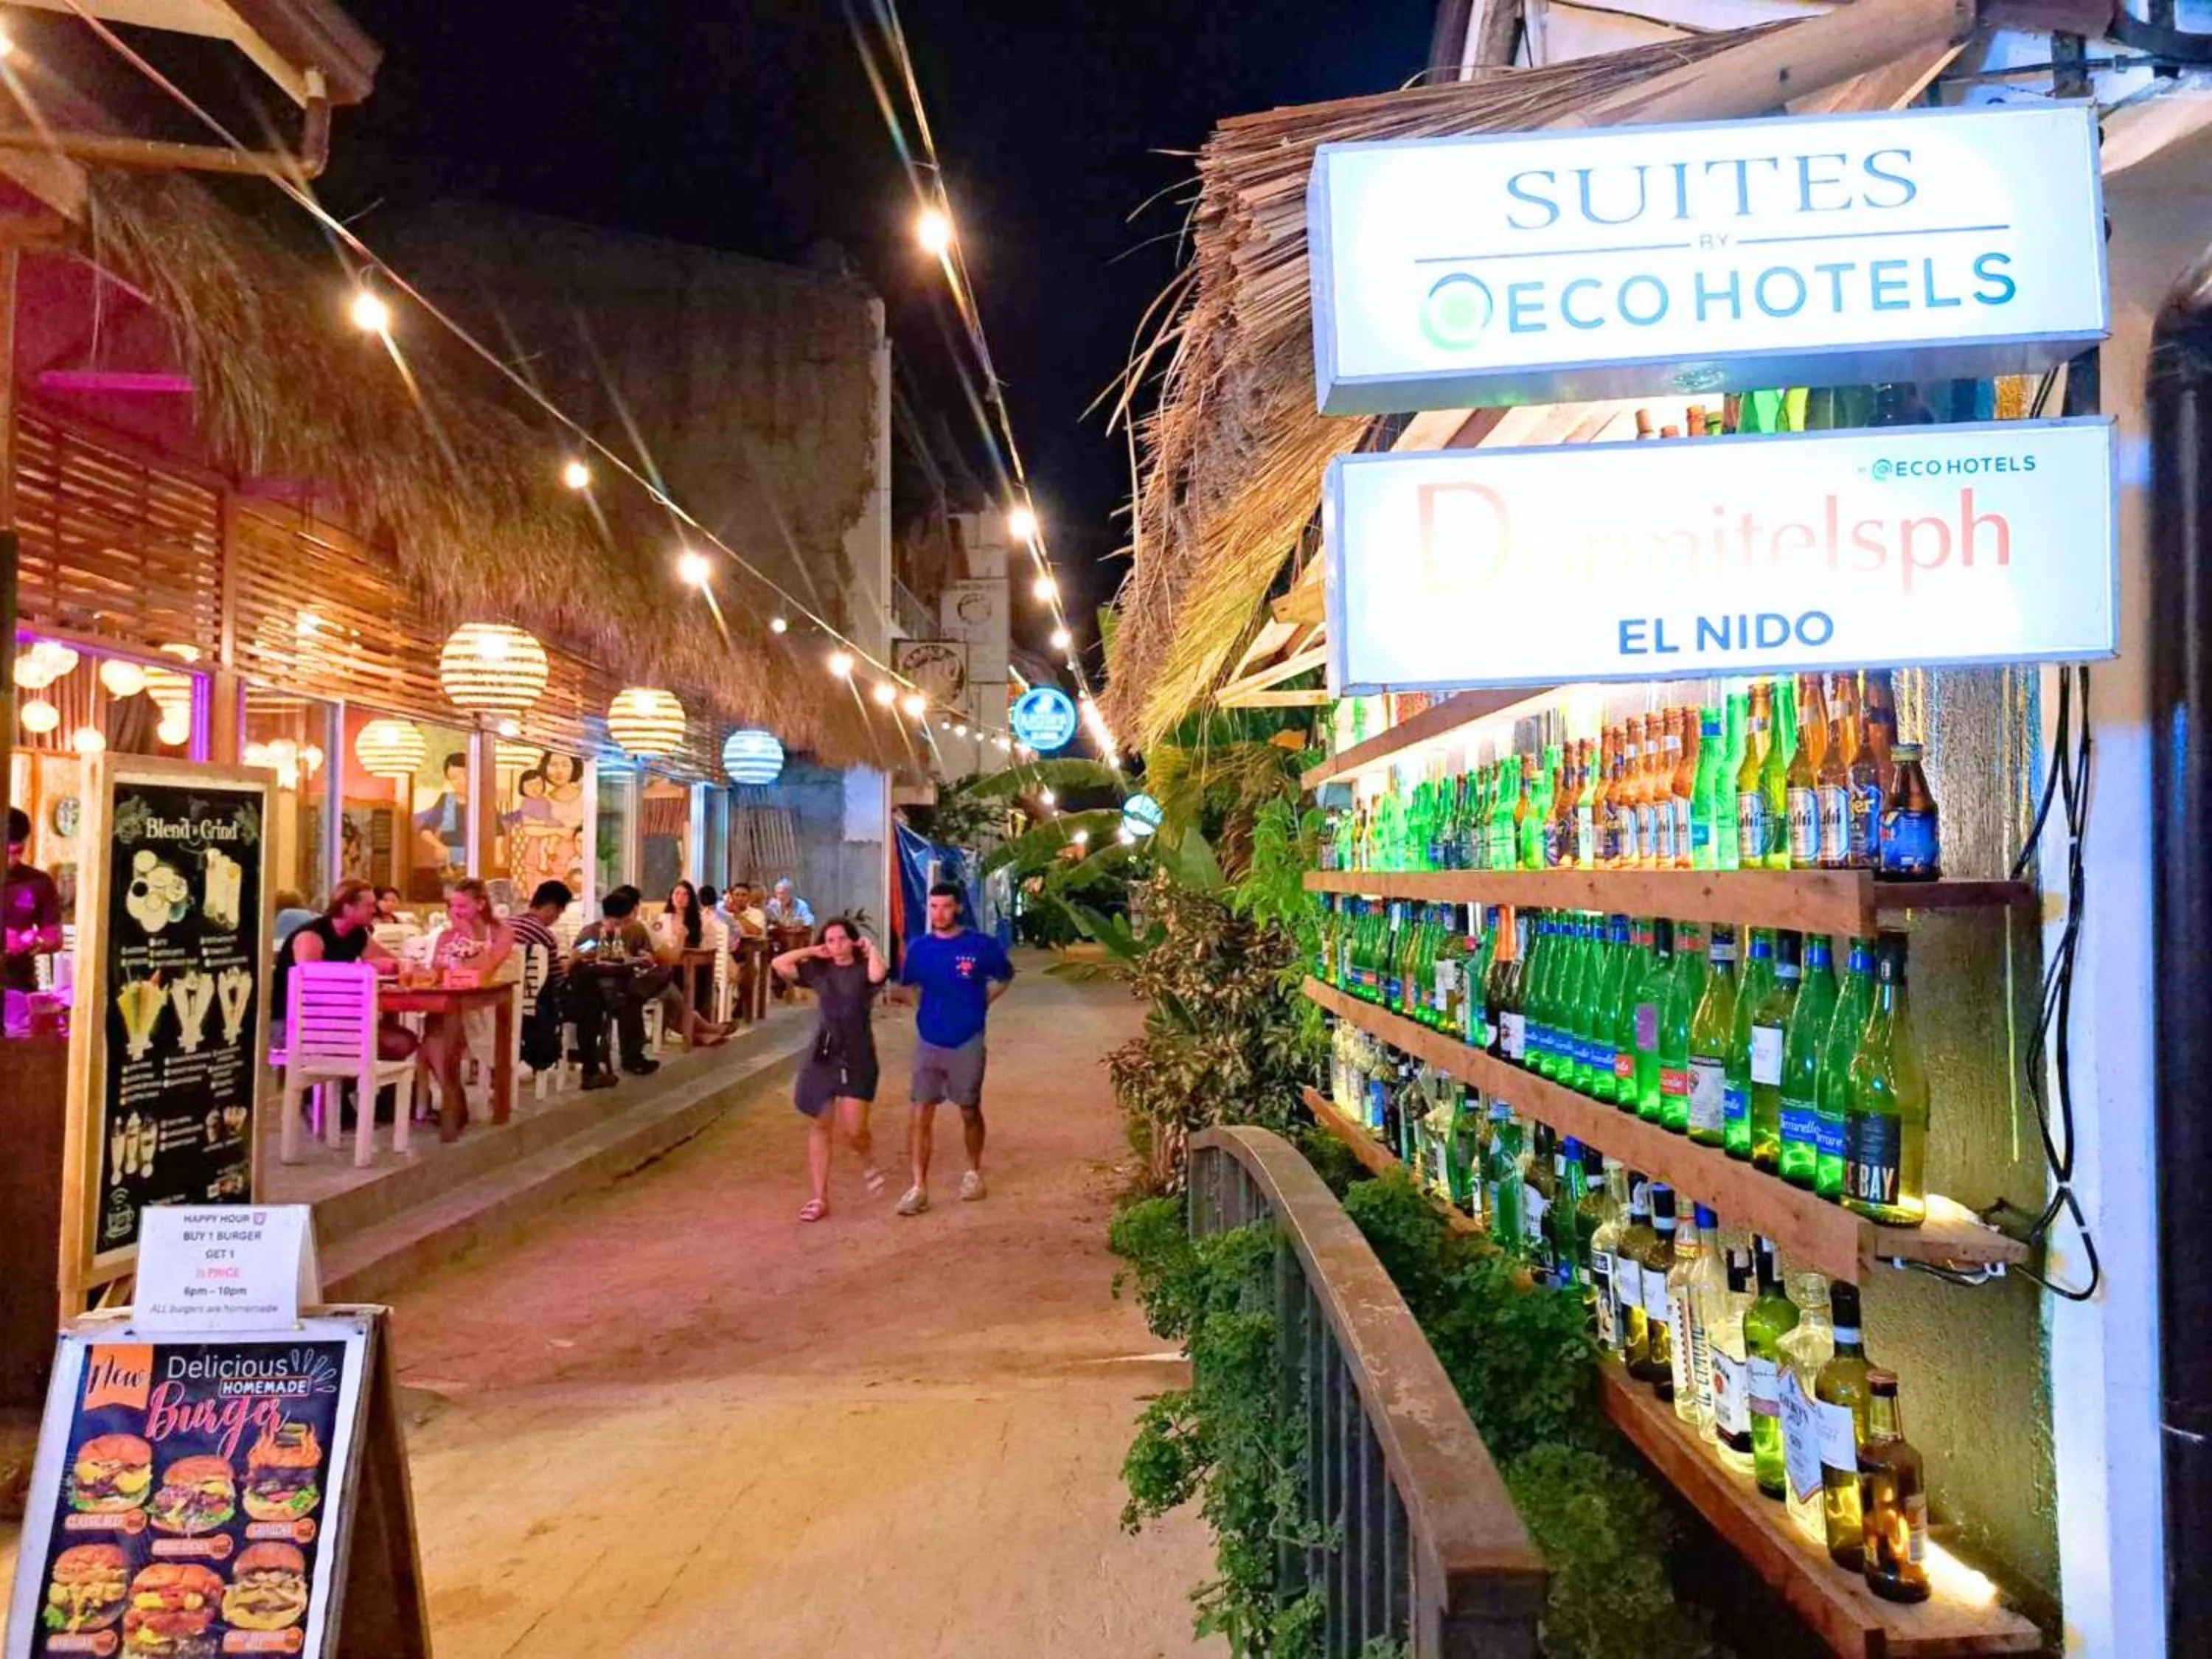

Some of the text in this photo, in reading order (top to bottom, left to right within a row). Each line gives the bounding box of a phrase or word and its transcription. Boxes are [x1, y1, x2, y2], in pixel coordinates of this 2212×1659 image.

[1505, 148, 1919, 231] SUITES
[1698, 232, 1730, 251] BY
[1506, 251, 2017, 335] ECO HOTELS
[1947, 455, 2037, 475] HOTELS
[1618, 610, 1836, 655] EL NIDO
[146, 816, 238, 840] Blend Grind
[1859, 1164, 1895, 1202] BAY
[183, 1214, 250, 1223] HAPPY HOUR
[183, 1231, 205, 1241] BUY
[216, 1231, 262, 1241] BURGER
[205, 1249, 226, 1259] GET
[218, 1286, 248, 1297] 10pm
[150, 1304, 167, 1313] ALL
[169, 1304, 205, 1315] burgers
[223, 1303, 279, 1313] homemade
[88, 1352, 147, 1395] New
[167, 1354, 289, 1379] Delicious
[222, 1380, 307, 1394] HOMEMADE
[145, 1380, 292, 1461] Burger
